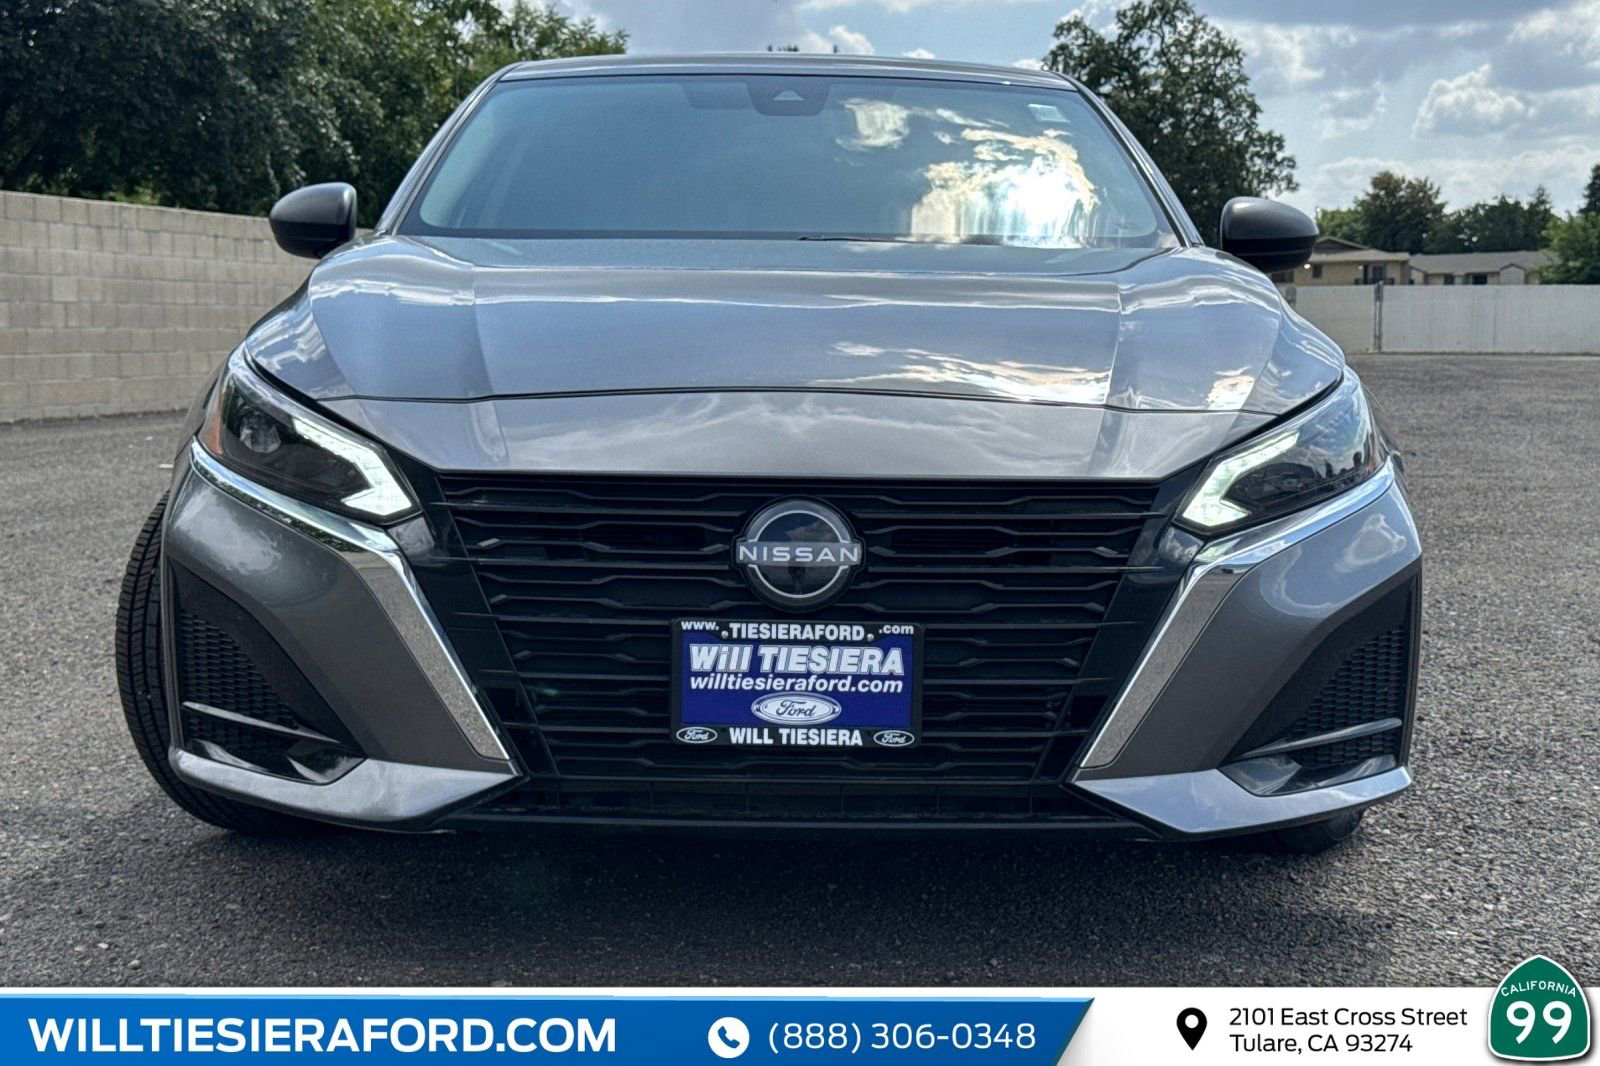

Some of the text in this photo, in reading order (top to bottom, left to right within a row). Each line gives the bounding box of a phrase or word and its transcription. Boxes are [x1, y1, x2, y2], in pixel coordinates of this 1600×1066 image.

[739, 547, 858, 562] NISSAN
[729, 623, 865, 641] TIESIERAFORD
[758, 646, 904, 674] TIESIERA
[690, 673, 903, 693] willtiesieraford.com
[775, 700, 816, 717] Ford
[729, 728, 863, 746] WILL TIESIERA
